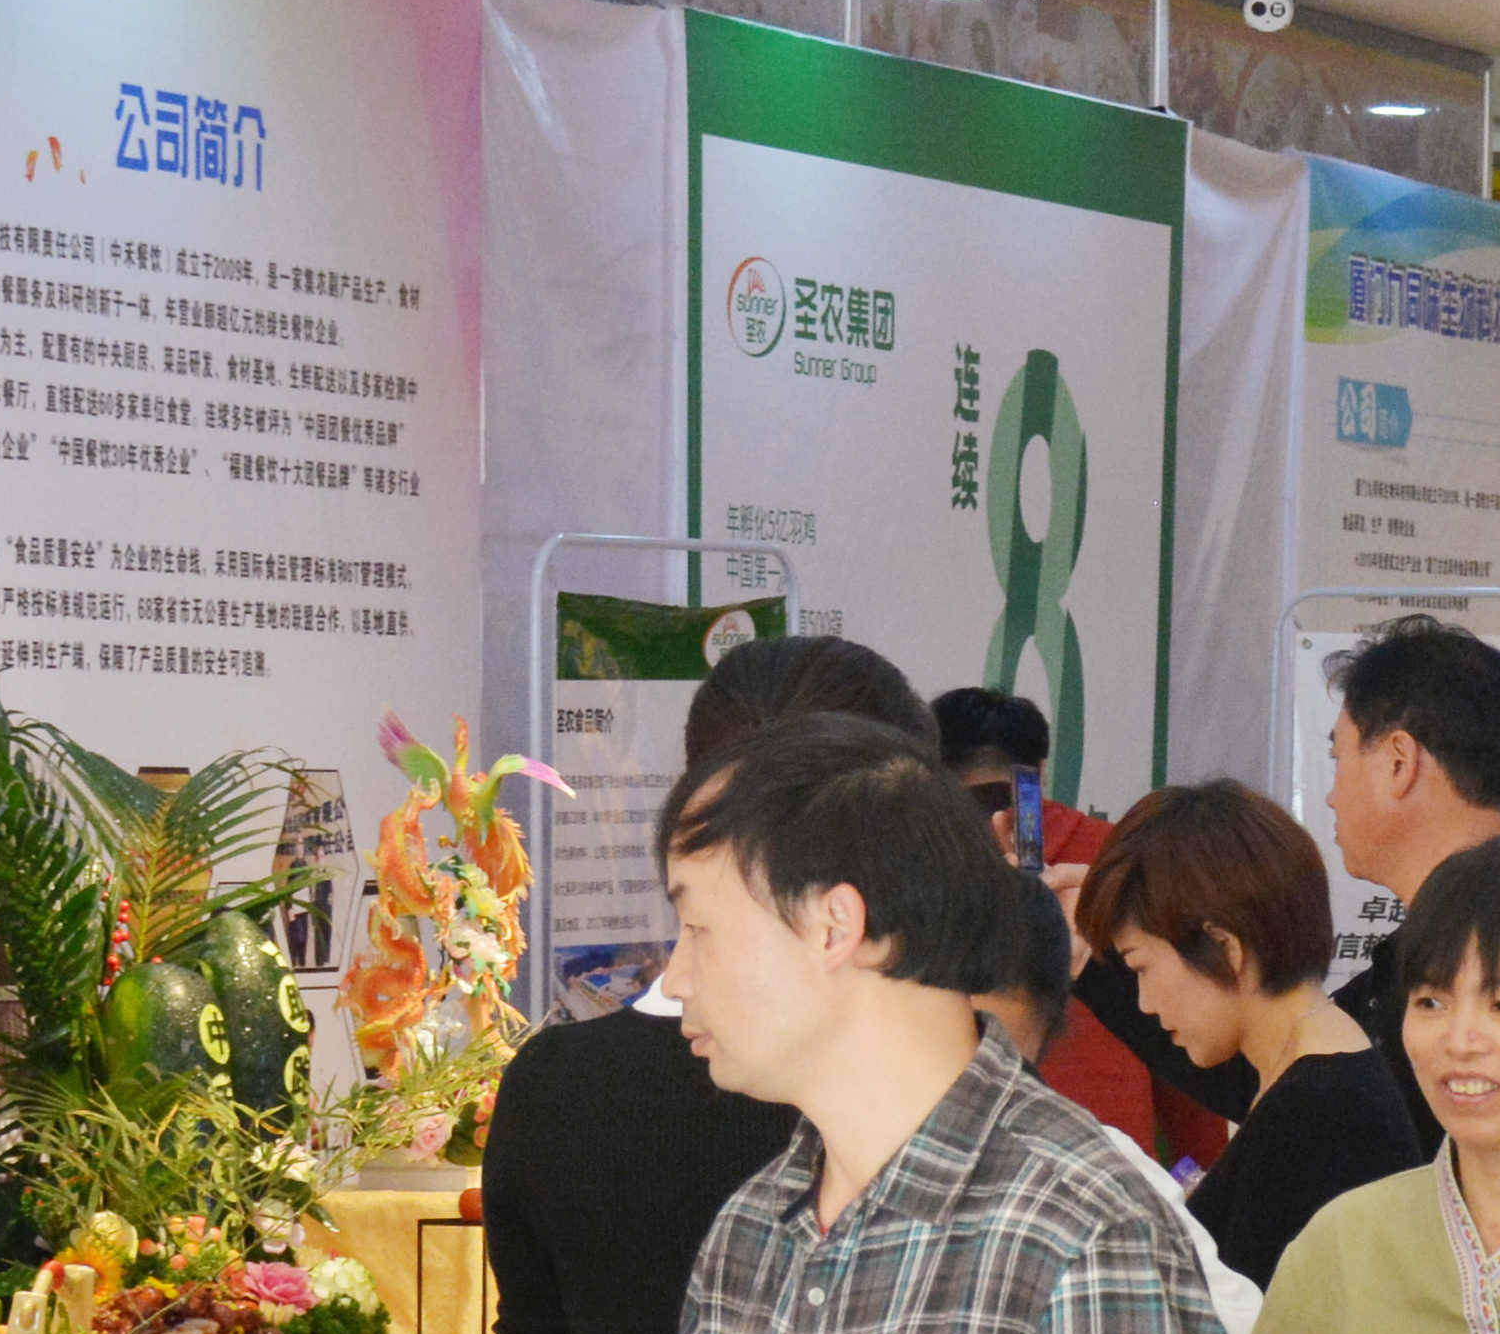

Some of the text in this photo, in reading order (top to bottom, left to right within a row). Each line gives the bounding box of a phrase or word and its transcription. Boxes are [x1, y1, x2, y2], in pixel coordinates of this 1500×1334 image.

[113, 82, 268, 193] 公司简介
[746, 317, 767, 344] 圣农
[794, 277, 896, 352] 圣农集团
[794, 351, 877, 387] Sunner Group
[952, 342, 980, 511] 连续
